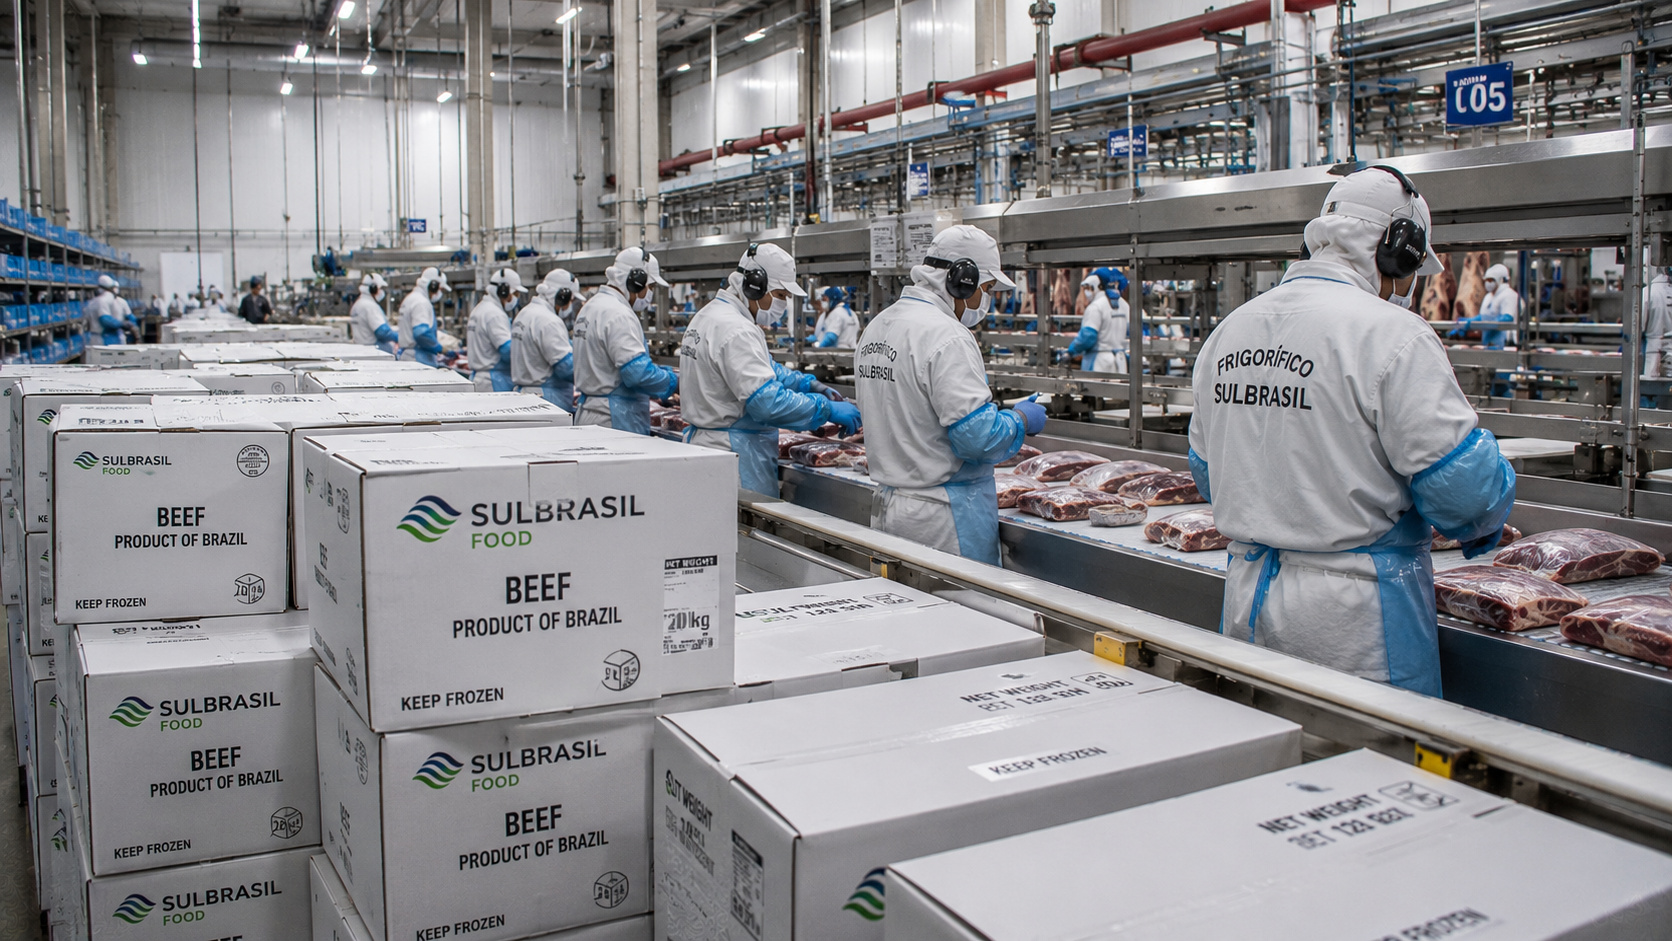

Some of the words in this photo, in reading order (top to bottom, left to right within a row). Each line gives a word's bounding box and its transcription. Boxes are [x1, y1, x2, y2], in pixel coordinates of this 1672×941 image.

[1217, 344, 1314, 378] FRIGORÍFICO
[1214, 383, 1312, 410] SULBRASIL
[102, 455, 172, 466] SULBRASIL
[102, 467, 131, 476] FOOD
[157, 506, 206, 527] BEEF
[471, 494, 645, 528] SULBRASIL
[114, 533, 178, 549] PRODUCT
[181, 533, 199, 546] OF
[202, 532, 248, 546] BRAZIL
[471, 530, 533, 550] FOOD
[505, 572, 572, 605] BEEF
[75, 599, 103, 610] KEEP
[105, 597, 147, 608] FROZEN
[452, 612, 534, 639] PRODUCT
[538, 611, 561, 631] OF
[565, 606, 622, 628] BRAZIL
[160, 691, 281, 717] SULBRASIL
[400, 694, 442, 712] KEEP
[445, 687, 505, 707] FROZEN
[160, 717, 203, 732] FOOD
[190, 746, 241, 771] BEEF
[471, 739, 607, 774] SULBRASIL
[989, 761, 1035, 775] KEEP
[1038, 746, 1108, 765] FROZEN
[150, 777, 214, 798] PRODUCT
[216, 775, 234, 790] OF
[238, 769, 284, 787] BRAZIL
[471, 773, 520, 792] FOOD
[505, 804, 562, 837] BEEF
[1257, 817, 1306, 834] NET
[1300, 794, 1381, 822] WEIGHT
[113, 845, 144, 860] KEEP
[147, 839, 192, 855] FROZEN
[459, 843, 530, 870] PRODUCT
[534, 839, 554, 856] OF
[558, 829, 609, 854] BRAZIL
[162, 880, 283, 912] SULBRASIL
[163, 910, 206, 927] FOOD
[416, 925, 450, 941] KEEP
[454, 914, 505, 936] FROZEN
